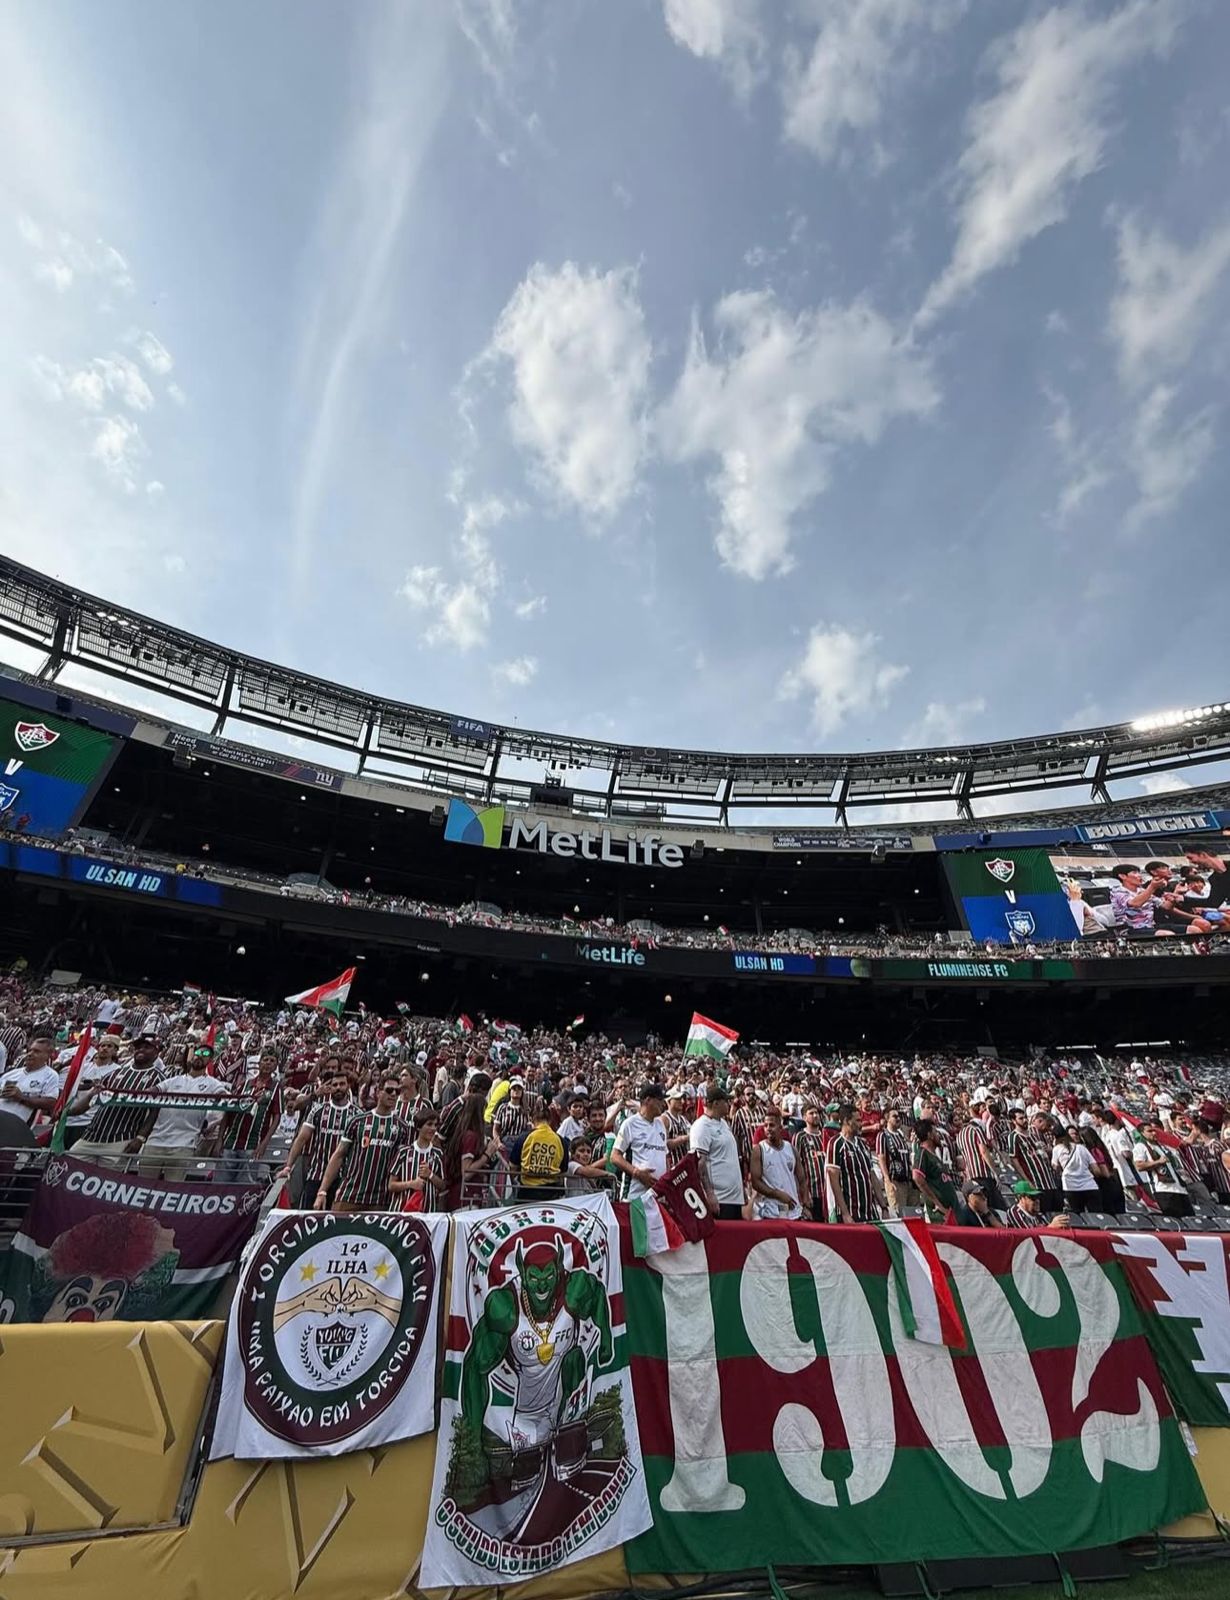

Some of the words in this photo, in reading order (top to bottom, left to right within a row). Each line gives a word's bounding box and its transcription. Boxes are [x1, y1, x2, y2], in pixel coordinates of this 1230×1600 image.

[457, 720, 484, 733] FIFA
[173, 733, 197, 744] Need
[1085, 822, 1137, 839] BUD
[1135, 815, 1211, 834] LIGHT
[508, 816, 684, 868] MetLife
[85, 864, 137, 888] ULSAN
[137, 874, 162, 892] HD
[575, 945, 646, 966] MetLife
[734, 956, 768, 970] ULSAN
[770, 958, 784, 971] HD
[928, 963, 993, 976] FLUMINENSE
[995, 964, 1009, 976] FC
[116, 1092, 215, 1107] FLUMINENSE
[217, 1098, 238, 1108] FC
[532, 1142, 557, 1156] CSC
[530, 1154, 555, 1167] EVENT
[65, 1171, 236, 1215] CORNETEIROS
[684, 1187, 708, 1220] 9
[251, 1213, 337, 1302] TORCIDA
[348, 1213, 420, 1249] YOUNG
[410, 1253, 428, 1303] FLU
[326, 1259, 369, 1275] ILHA
[554, 1328, 571, 1343] FFC
[319, 1400, 351, 1428] EM
[355, 1326, 419, 1411] TORCIDA
[646, 1235, 1161, 1512] 1902
[436, 1499, 455, 1524] O
[446, 1512, 479, 1558] SUL
[475, 1535, 500, 1570] DO
[500, 1538, 562, 1574] ESTADO
[562, 1508, 597, 1554] TEM
[592, 1457, 635, 1525] DONO!
